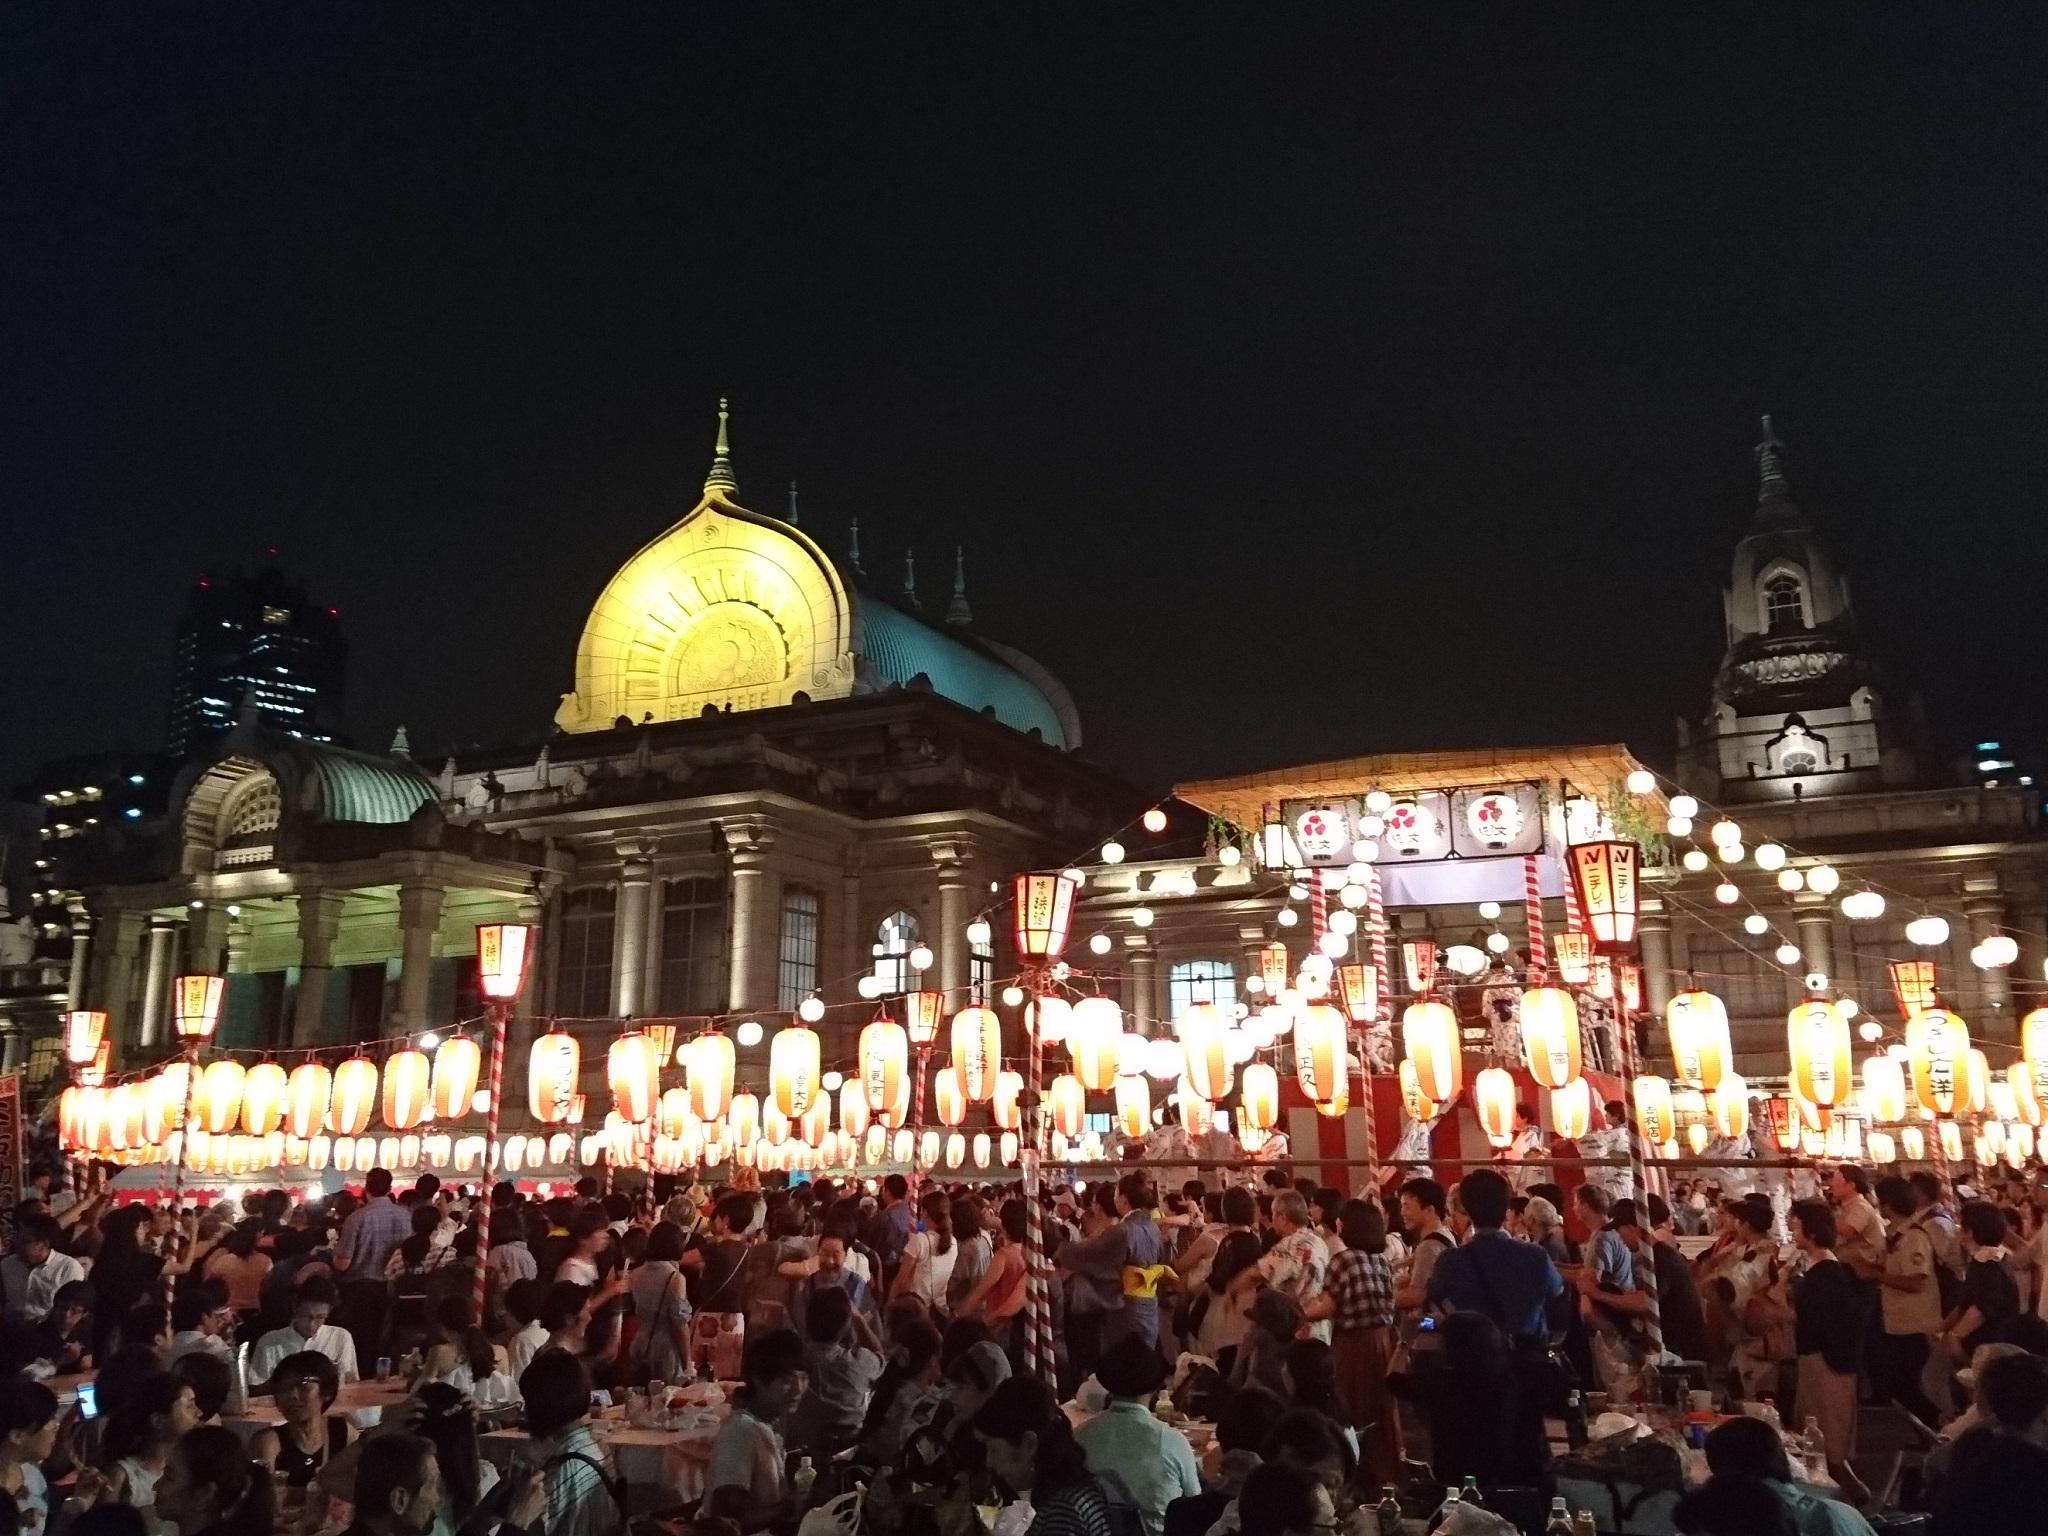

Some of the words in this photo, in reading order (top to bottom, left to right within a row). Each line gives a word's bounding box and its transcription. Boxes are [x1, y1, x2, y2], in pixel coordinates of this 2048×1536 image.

[1588, 868, 1603, 908] ニチレイ
[1617, 867, 1628, 904] ニチレイ
[1264, 958, 1272, 974] 紀文
[1276, 958, 1284, 974] 紀文
